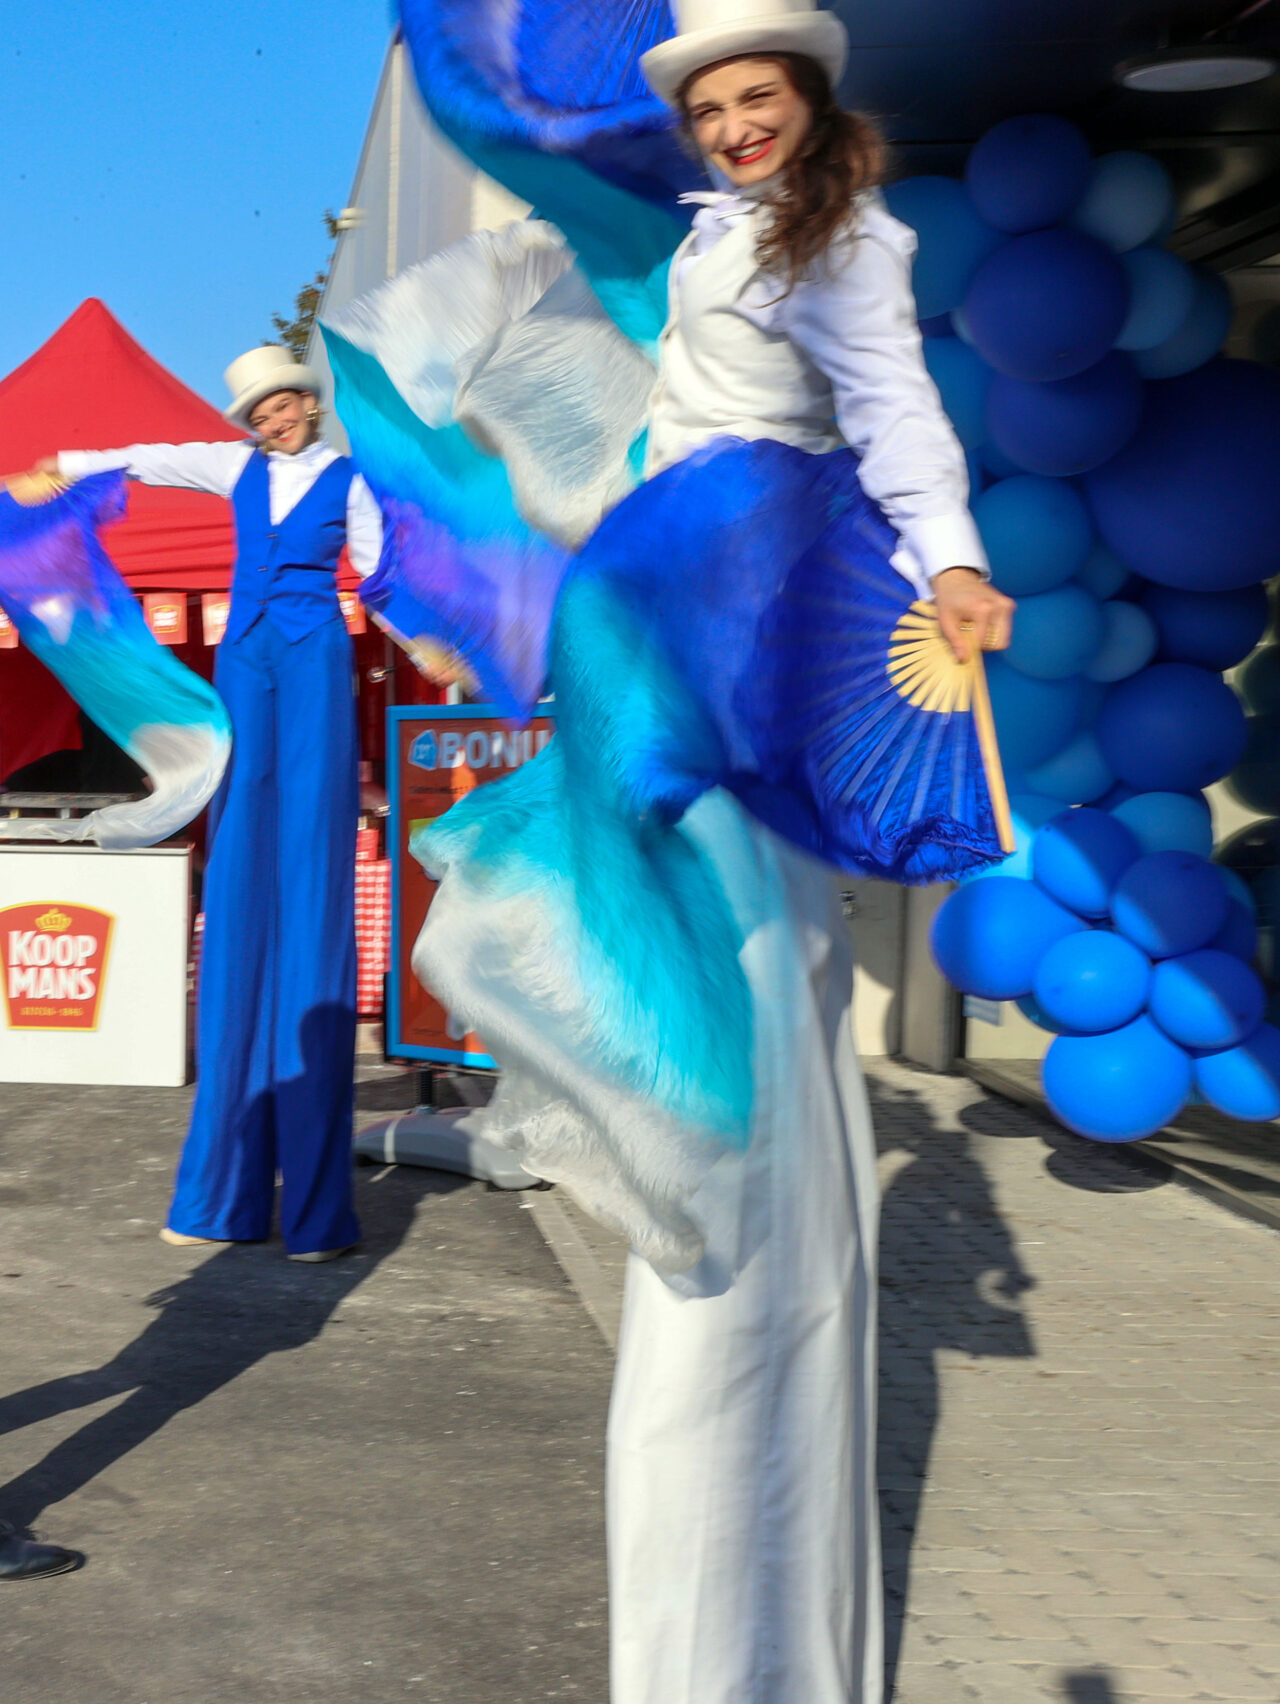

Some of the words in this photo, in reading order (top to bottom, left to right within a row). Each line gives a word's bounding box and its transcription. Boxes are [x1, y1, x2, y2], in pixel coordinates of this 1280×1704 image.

[439, 730, 552, 769] BONU
[7, 930, 98, 967] KOOP
[7, 966, 97, 1001] MANS
